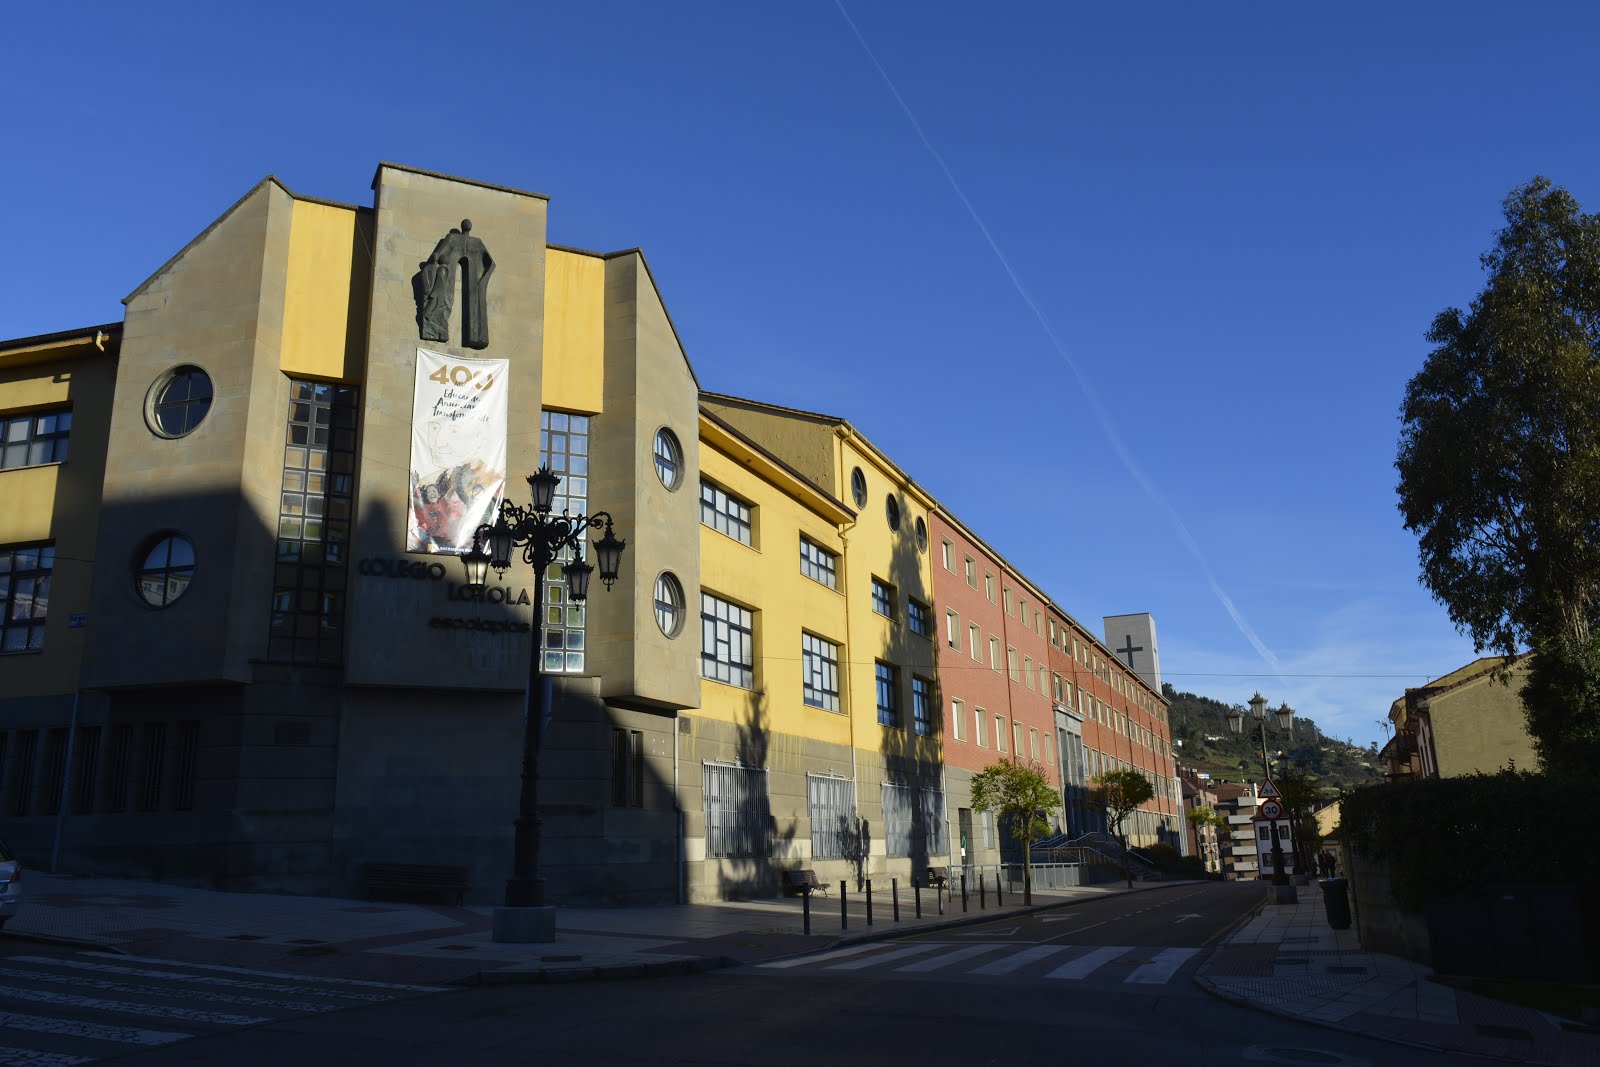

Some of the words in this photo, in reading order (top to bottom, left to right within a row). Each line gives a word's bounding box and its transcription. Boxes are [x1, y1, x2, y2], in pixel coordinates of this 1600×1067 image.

[429, 364, 494, 391] 400
[358, 558, 446, 580] COLEGIO
[448, 583, 531, 606] LOYOLA
[1265, 806, 1278, 815] 30
